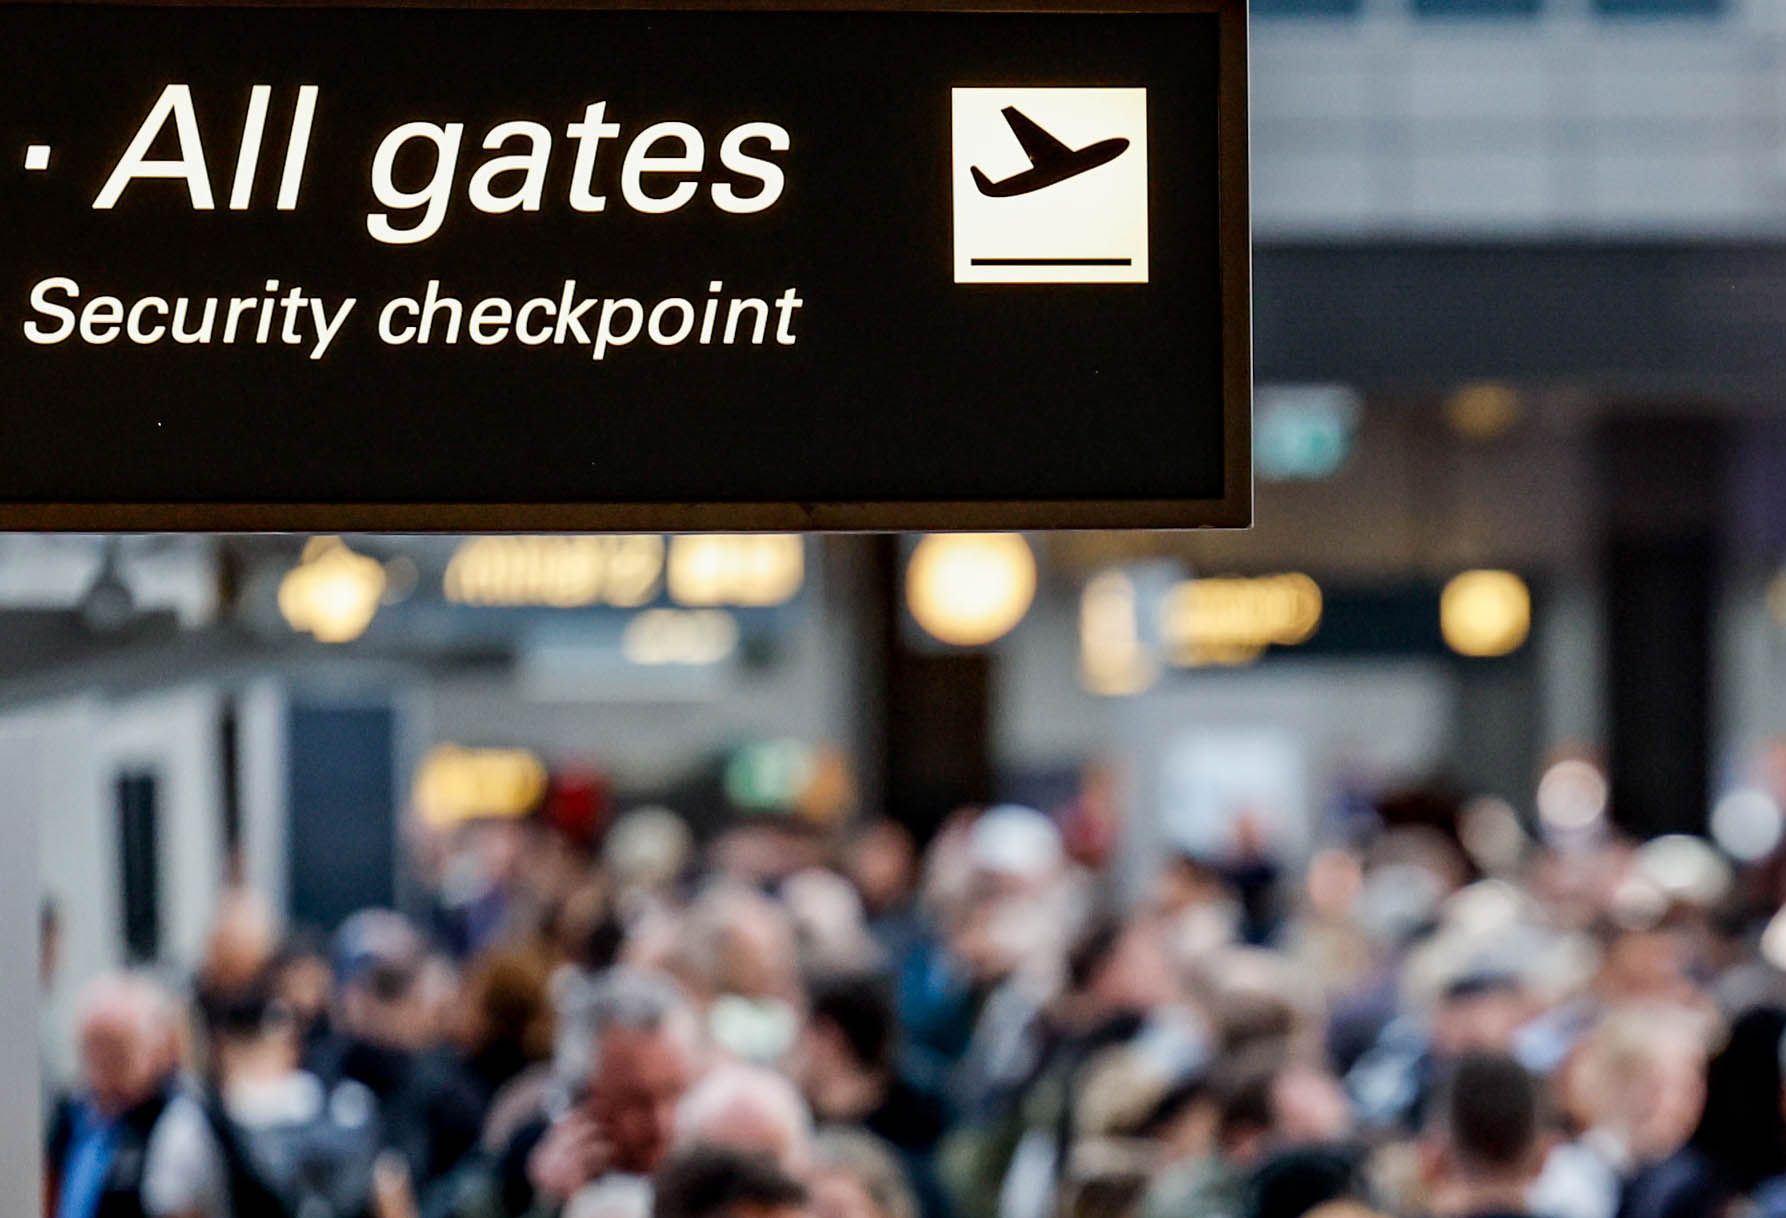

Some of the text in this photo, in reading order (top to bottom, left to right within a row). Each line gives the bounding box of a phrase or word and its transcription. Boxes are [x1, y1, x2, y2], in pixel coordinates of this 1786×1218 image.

[90, 84, 791, 244] All gates
[23, 276, 804, 361] Security checkpoint
